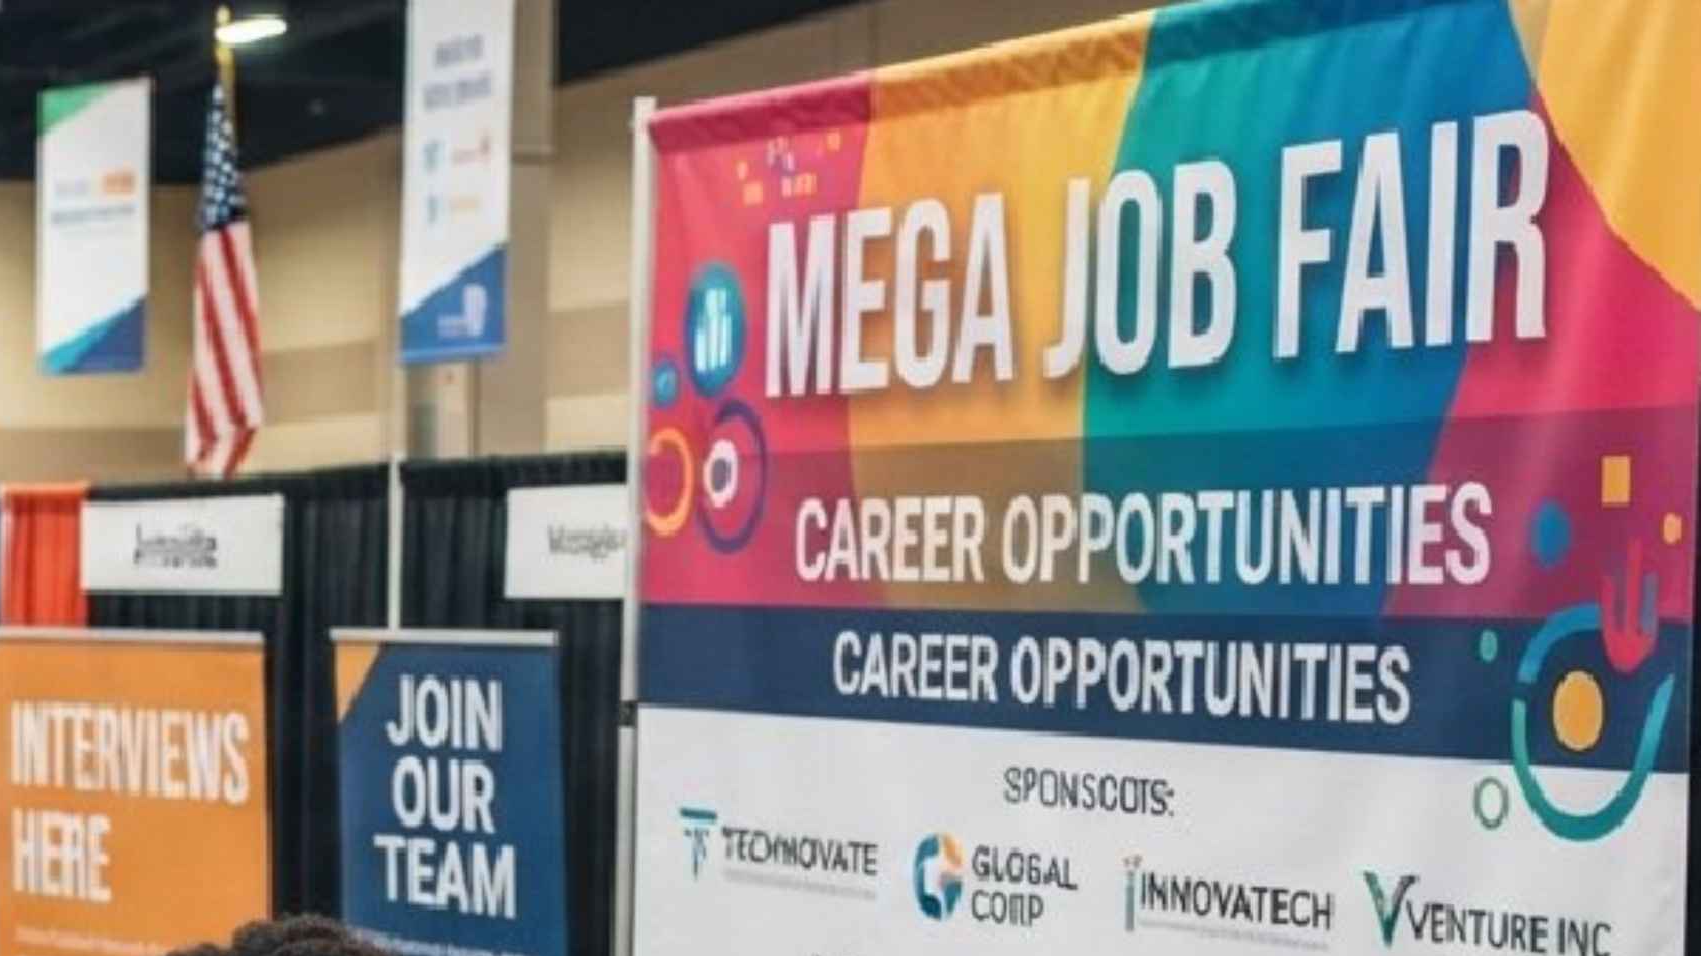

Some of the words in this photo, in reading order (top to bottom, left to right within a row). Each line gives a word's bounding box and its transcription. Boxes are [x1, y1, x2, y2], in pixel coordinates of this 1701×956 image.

[765, 193, 1014, 398] MEGA
[1043, 158, 1237, 379] JOB
[1273, 109, 1550, 361] FAIR
[795, 494, 985, 584] CAREER
[1002, 481, 1492, 587] OPPORTUNITIES
[386, 674, 503, 752] JOIN
[833, 629, 998, 702] CAREER
[1010, 634, 1412, 725] OPPORTUNITIES
[10, 700, 251, 807] INTERVIEWS
[392, 755, 496, 835] OUR
[11, 807, 113, 903] HERE
[373, 835, 517, 921] TEAM
[1404, 899, 1550, 954] VENTURE
